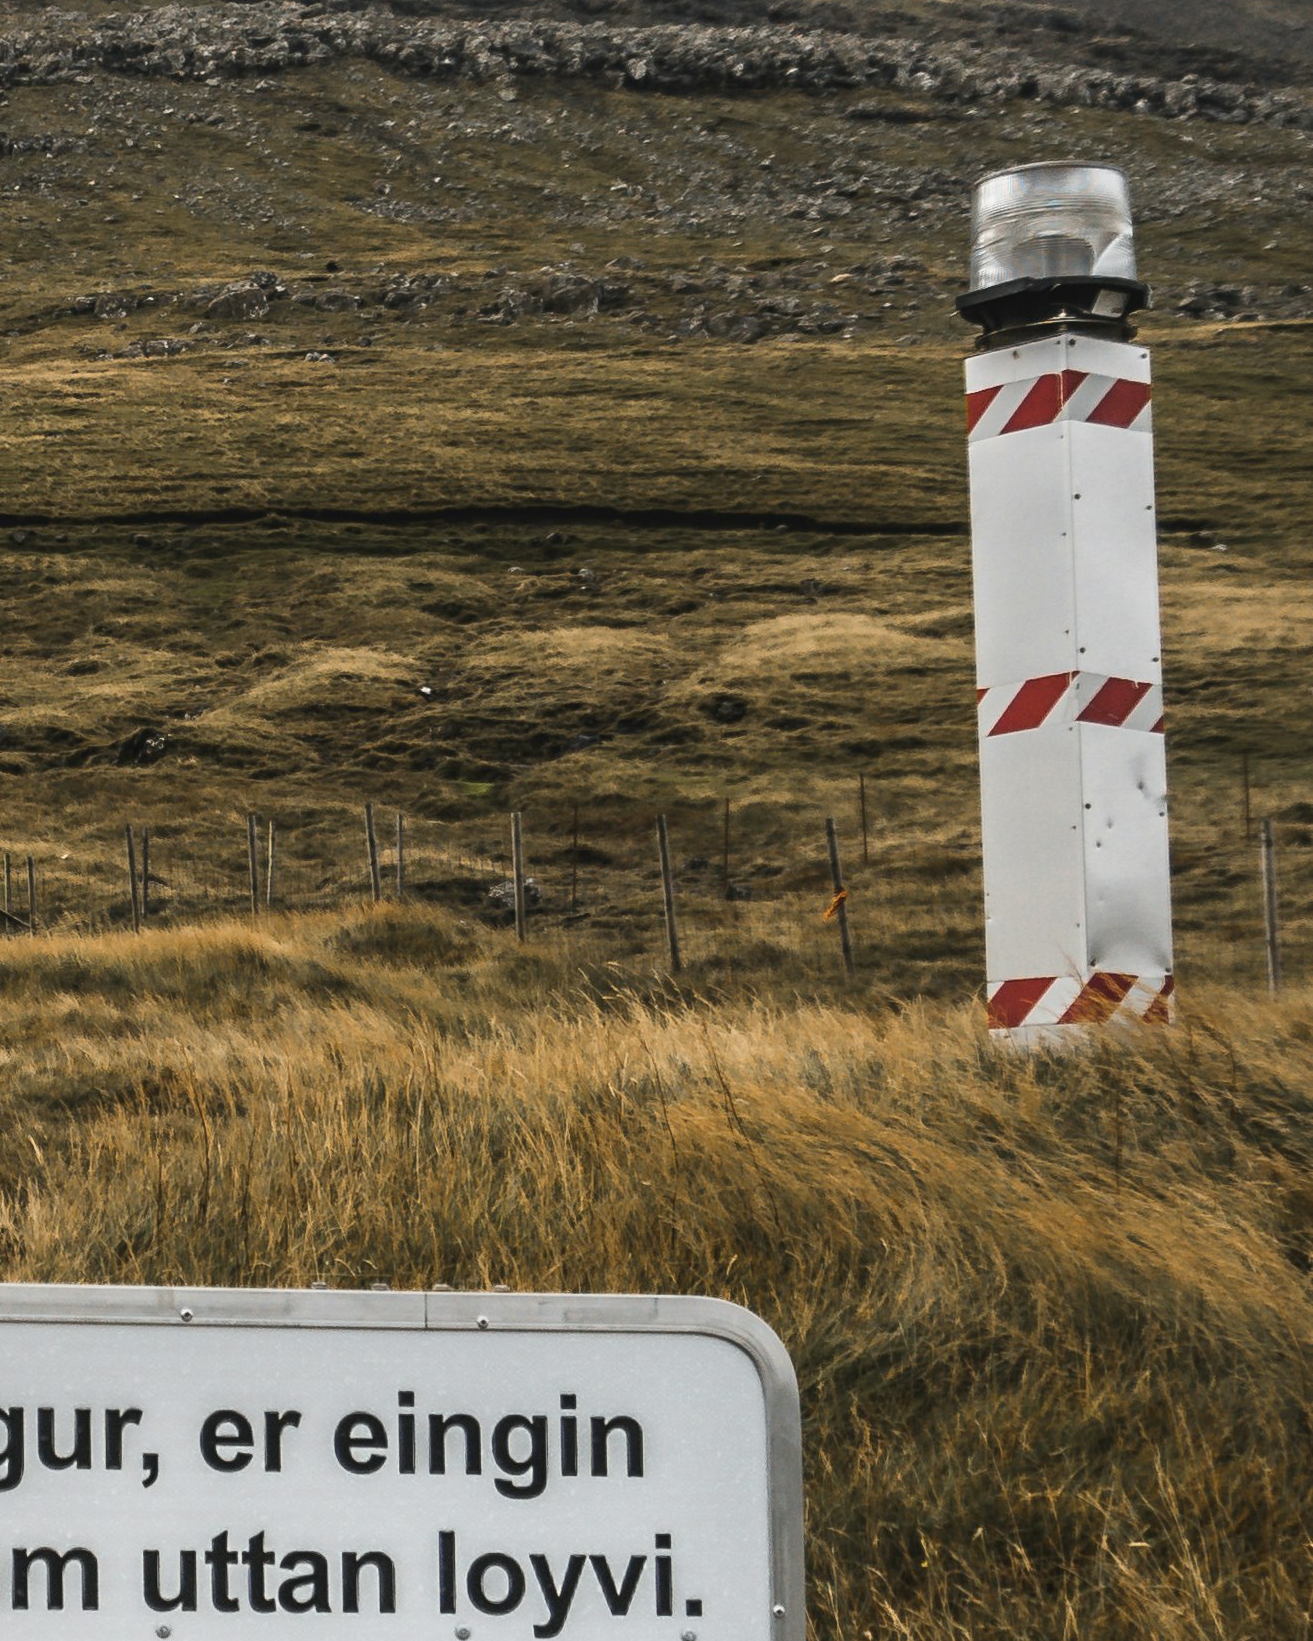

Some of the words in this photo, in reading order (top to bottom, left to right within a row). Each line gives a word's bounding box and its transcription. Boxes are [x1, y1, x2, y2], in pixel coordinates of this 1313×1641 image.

[198, 1408, 303, 1474] er
[333, 1389, 645, 1501] eingin
[141, 1529, 397, 1615] uttan
[437, 1529, 704, 1640] loyvi.
